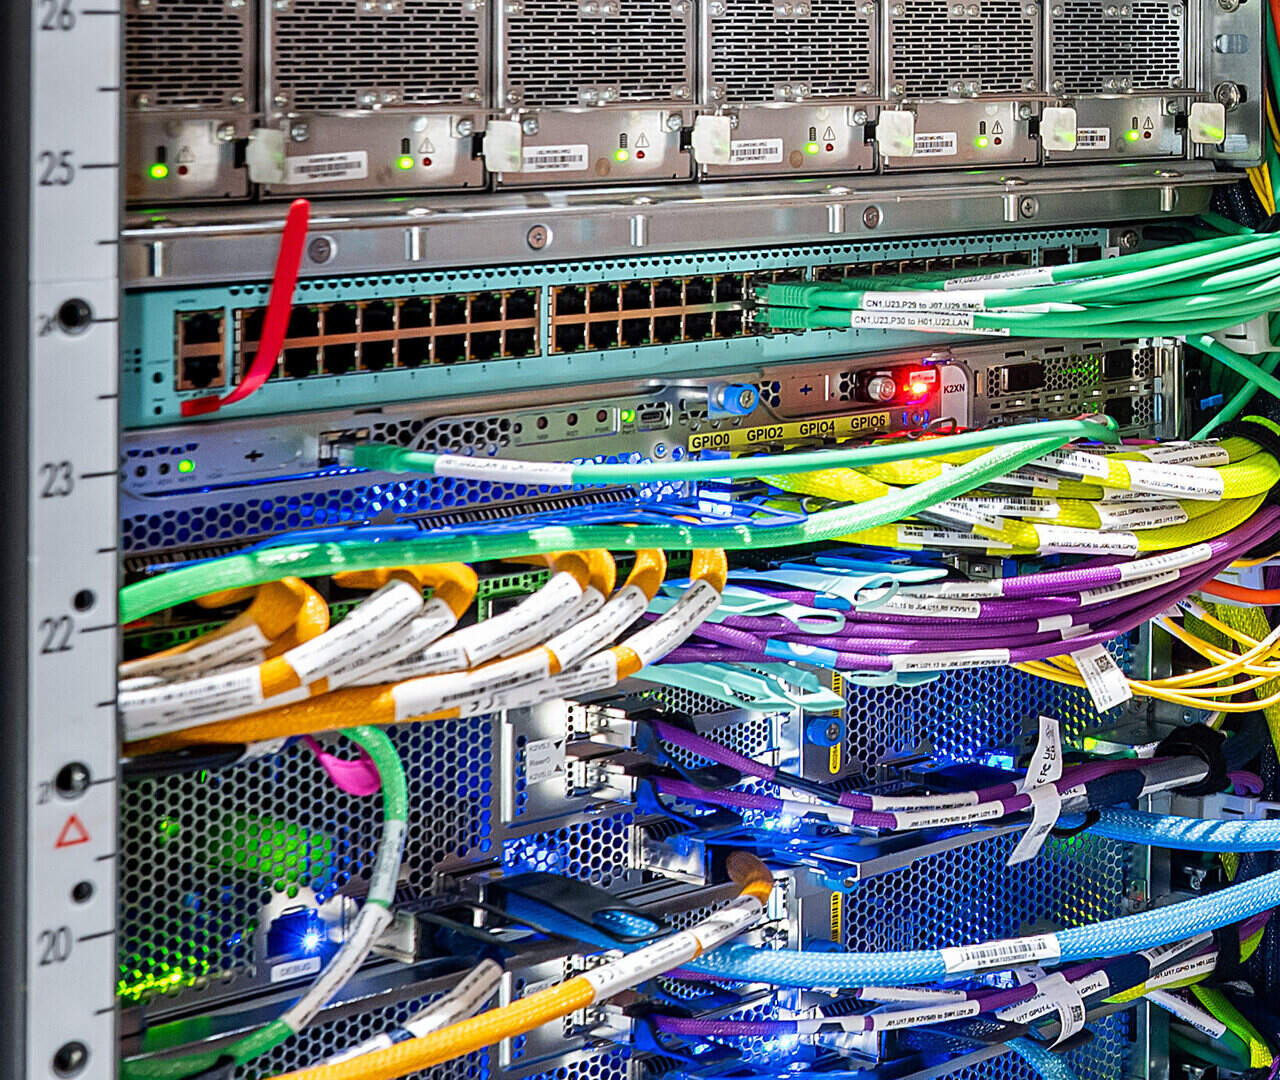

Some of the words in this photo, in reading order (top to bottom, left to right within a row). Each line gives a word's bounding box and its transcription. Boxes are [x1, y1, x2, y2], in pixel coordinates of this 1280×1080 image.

[39, 150, 75, 187] 25
[855, 315, 906, 325] CN1.U23.P30
[866, 299, 917, 309] CN1.U23.P29
[943, 383, 966, 394] K2XN
[692, 433, 730, 449] GPIO0
[746, 426, 783, 441] GPIO2
[799, 420, 835, 435] GPIO4
[850, 414, 886, 429] GPIO6
[40, 460, 75, 498] 23
[39, 615, 74, 654] 22
[38, 925, 73, 967] 20
